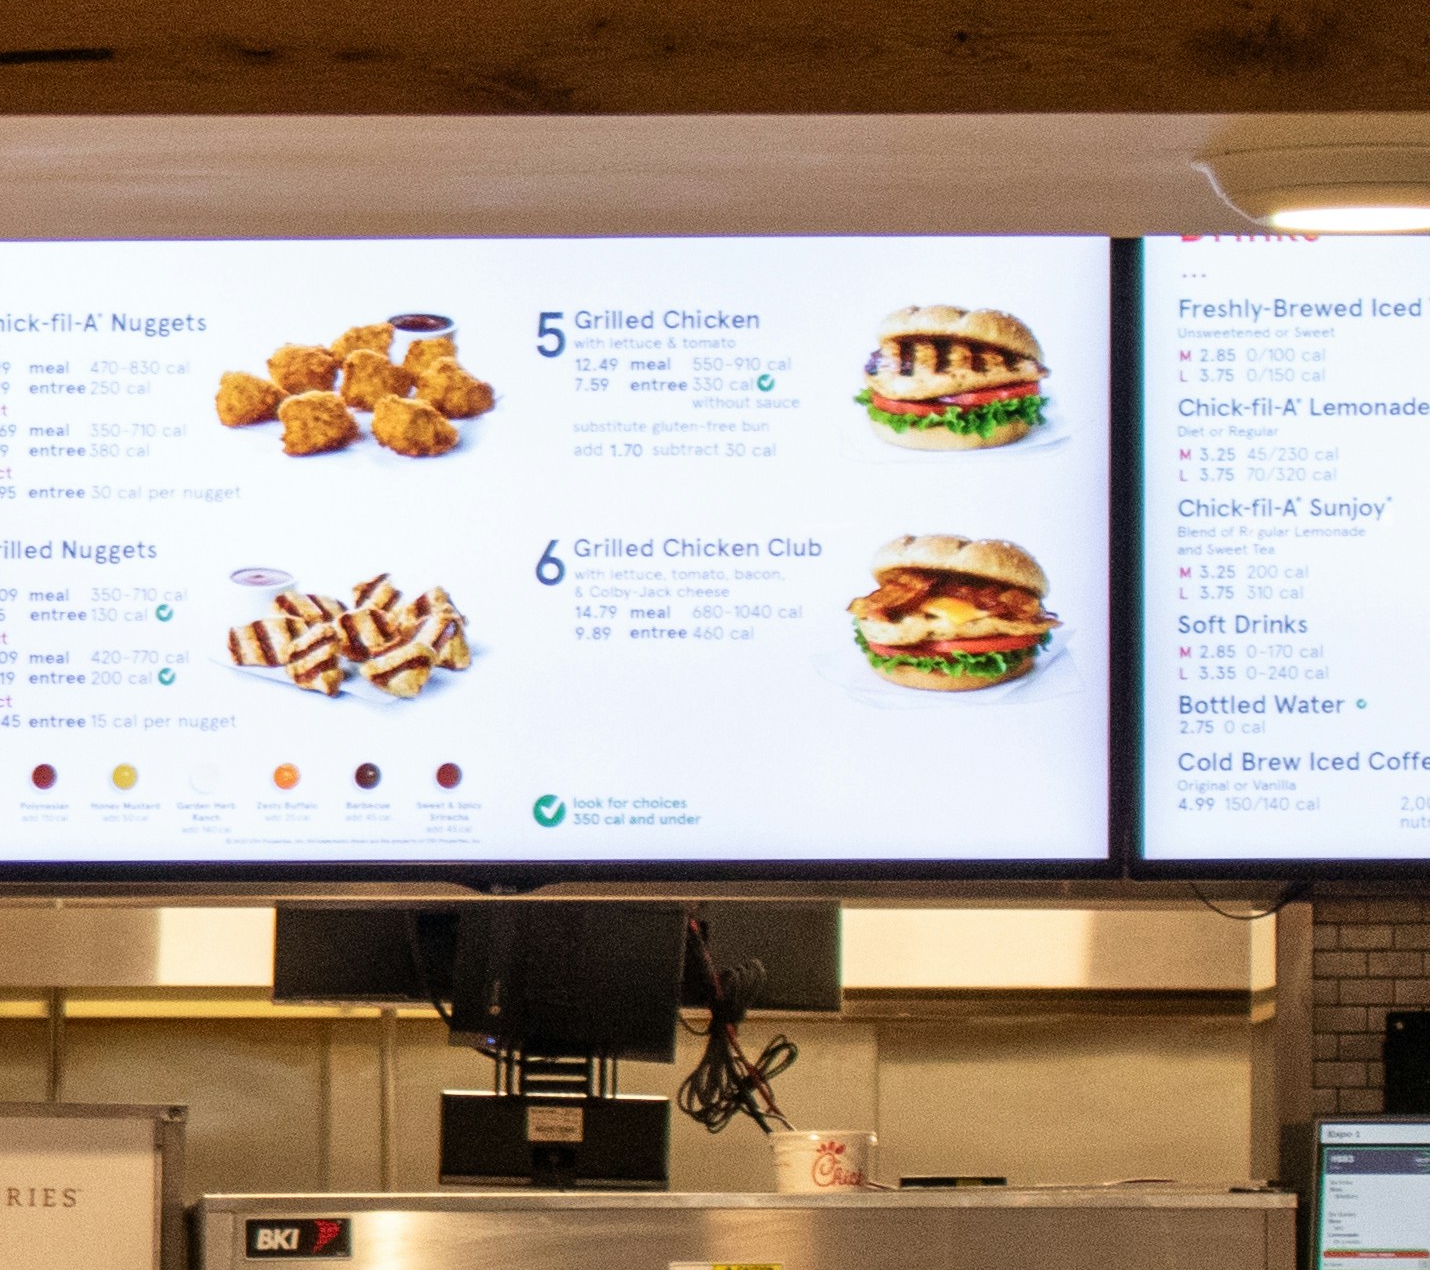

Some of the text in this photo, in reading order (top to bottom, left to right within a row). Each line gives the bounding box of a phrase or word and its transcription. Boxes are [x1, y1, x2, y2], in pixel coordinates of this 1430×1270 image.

[1179, 298, 1422, 322] Freshly-Brewed Iced
[111, 313, 207, 337] Nuggets
[536, 310, 760, 358] 5 Grilled Chicken
[1310, 398, 1430, 417] Lemonade
[62, 541, 158, 565] Nuggets
[535, 538, 822, 586] 6 Grilled Chicken Club
[1178, 615, 1308, 634] Soft Drinks
[1179, 695, 1345, 714] Bottled Water
[1178, 752, 1232, 772] Cold
[1242, 752, 1301, 772] Brew
[1309, 752, 1360, 772] Iced
[573, 797, 687, 809] look for choices
[573, 813, 701, 825] 350 cal and under
[257, 1229, 300, 1250] BKI
